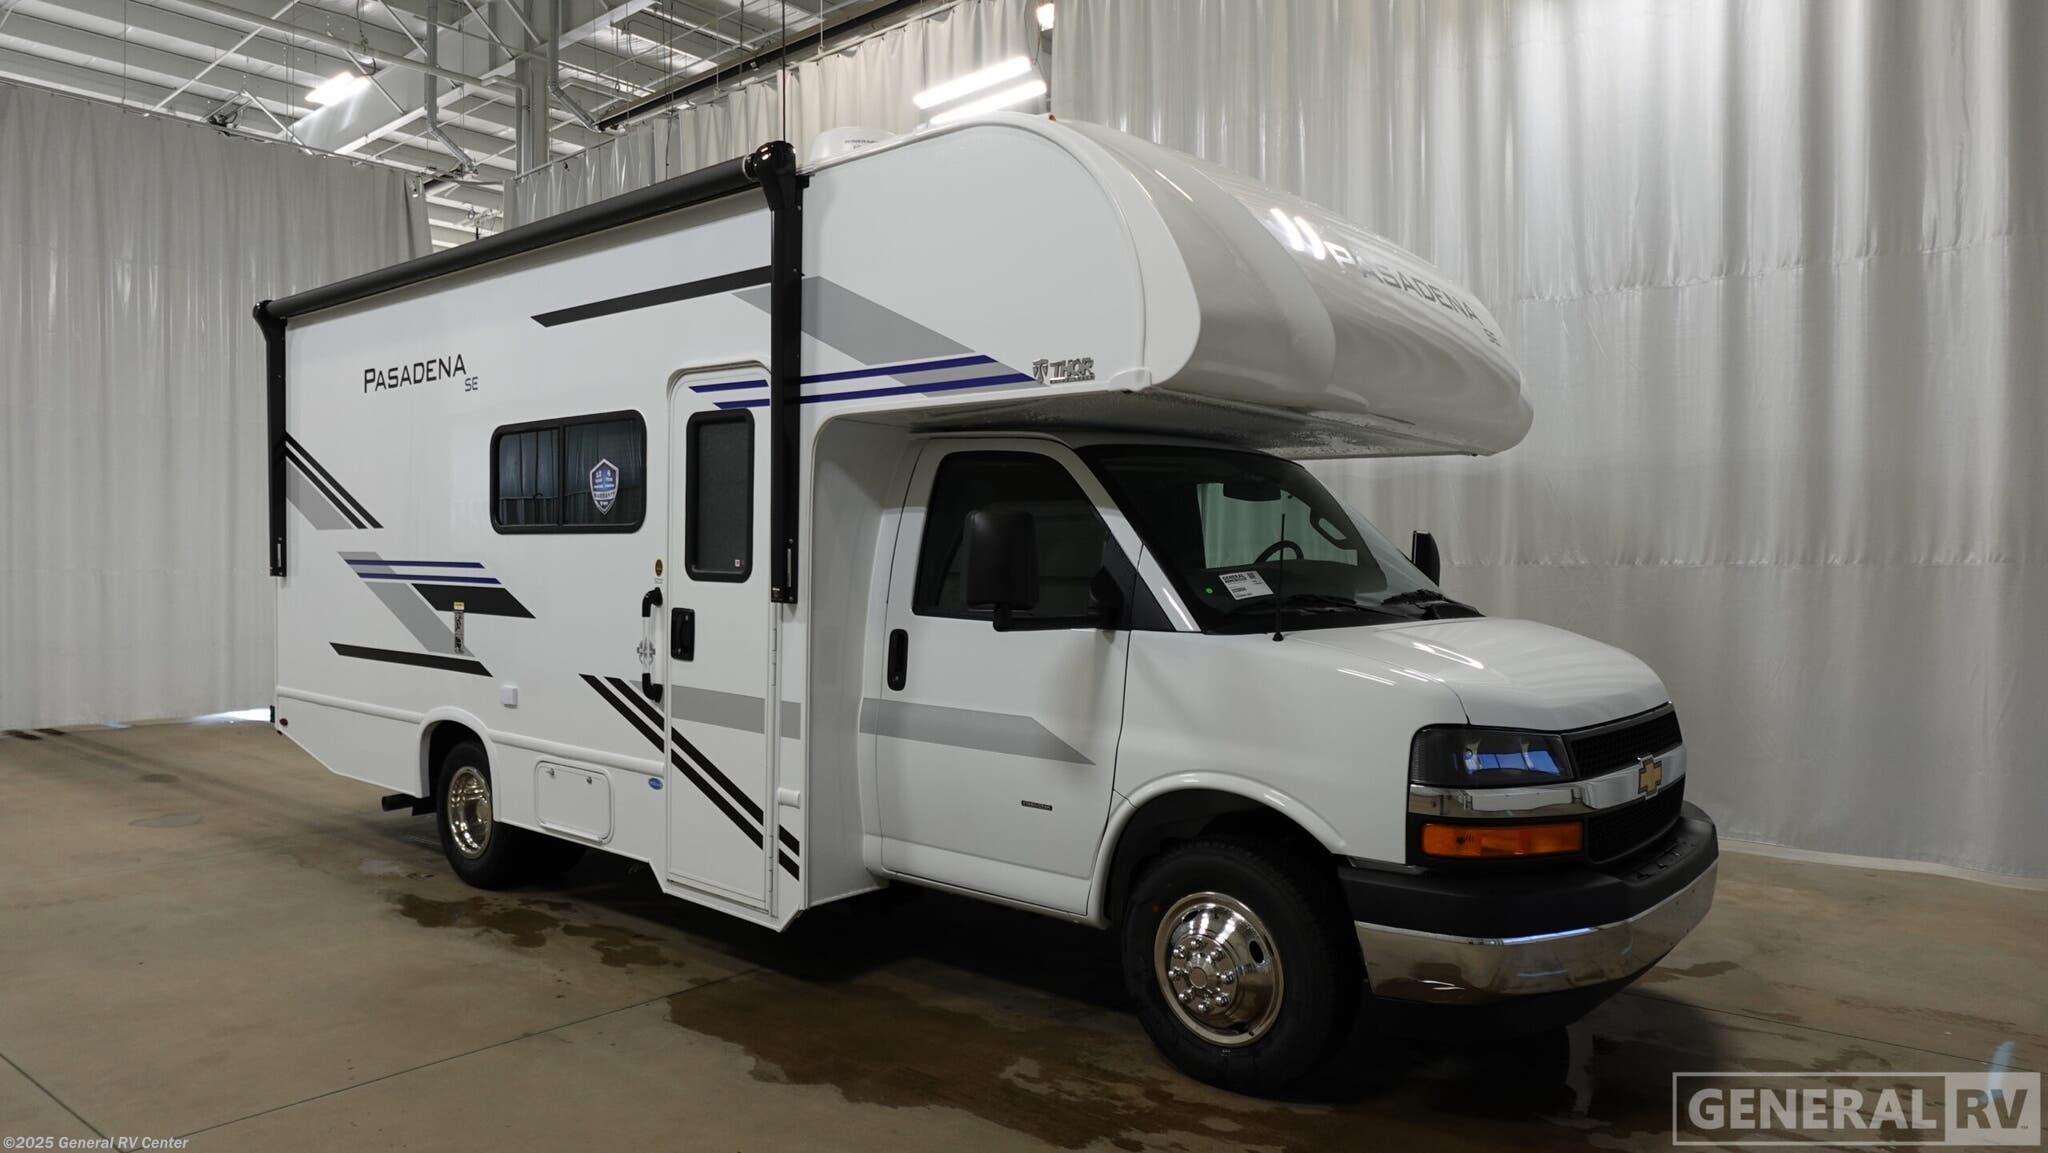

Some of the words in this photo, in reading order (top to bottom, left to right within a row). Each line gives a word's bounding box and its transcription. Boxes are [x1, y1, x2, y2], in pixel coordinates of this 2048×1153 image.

[364, 354, 467, 394] PASADENA
[1050, 357, 1094, 379] THOR
[464, 376, 479, 392] SE
